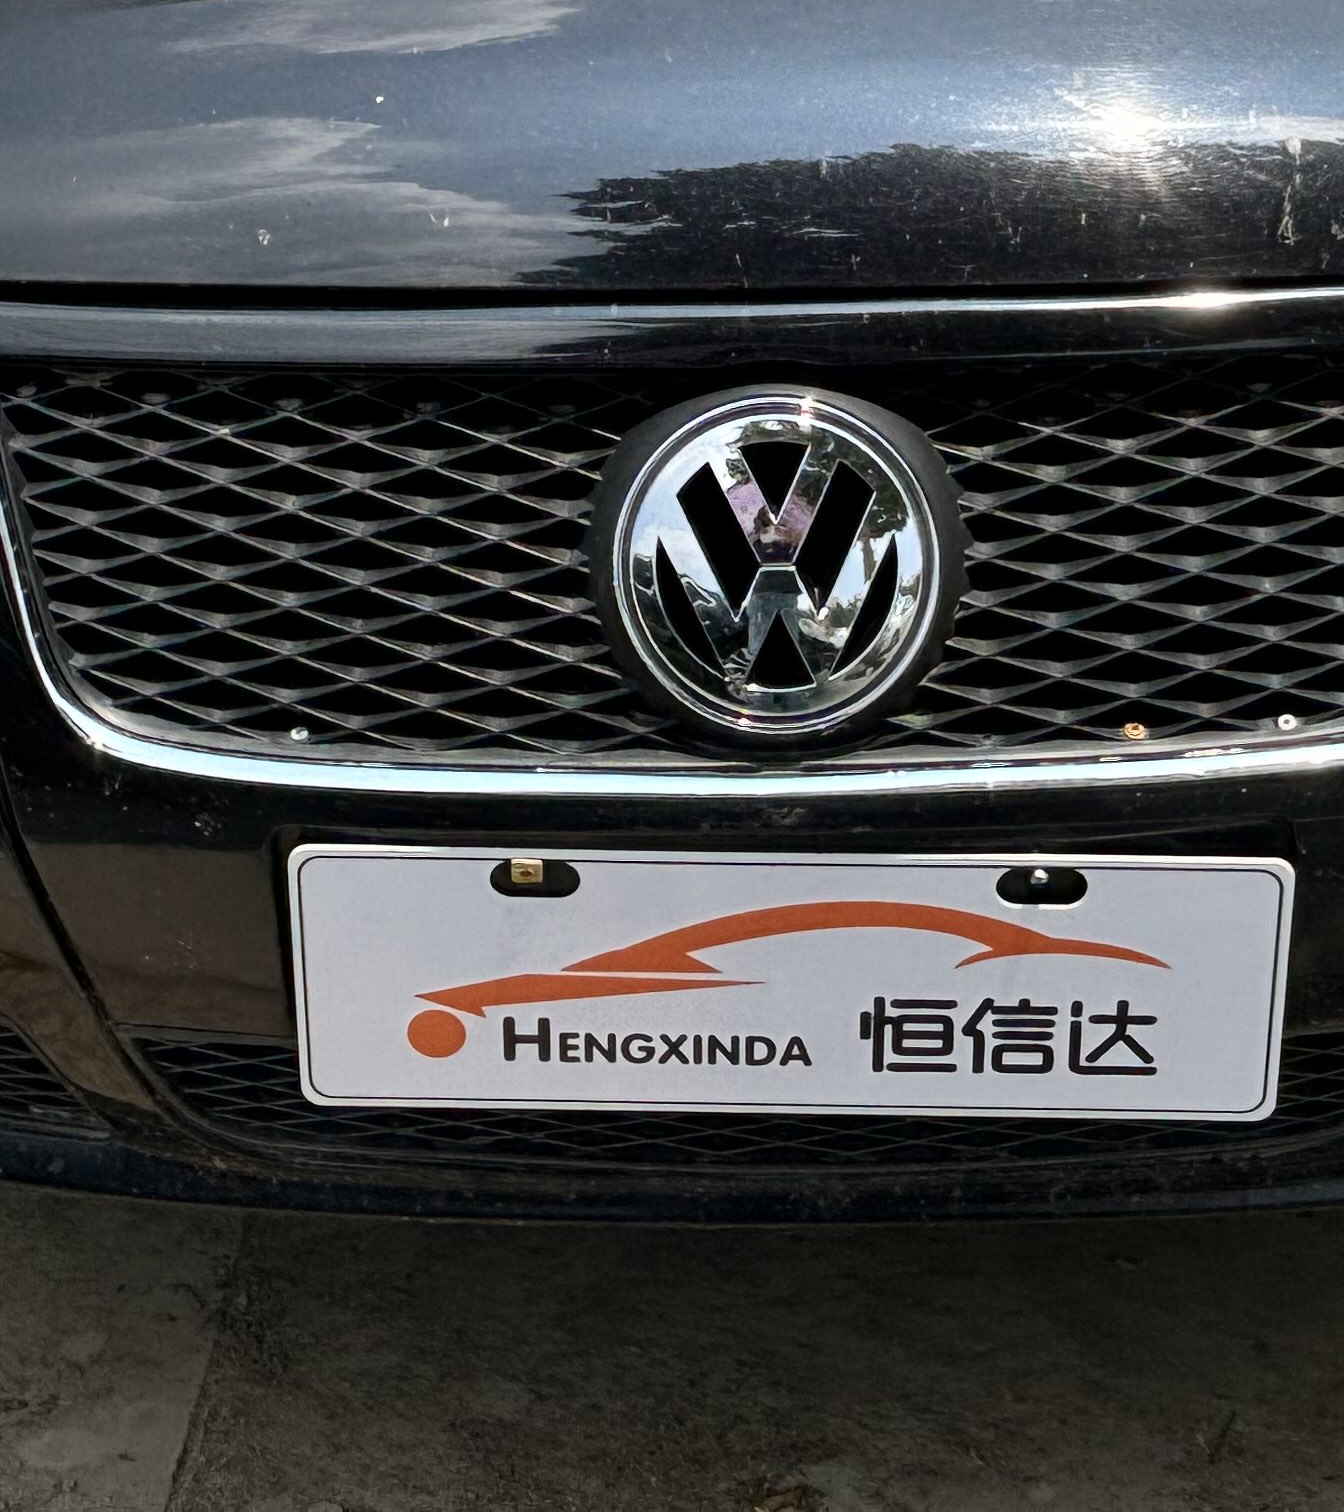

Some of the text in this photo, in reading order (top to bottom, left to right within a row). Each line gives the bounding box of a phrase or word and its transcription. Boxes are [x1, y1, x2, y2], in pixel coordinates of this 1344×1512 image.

[502, 1016, 813, 1067] HENGXINDA
[859, 995, 1159, 1077] 恒信达
